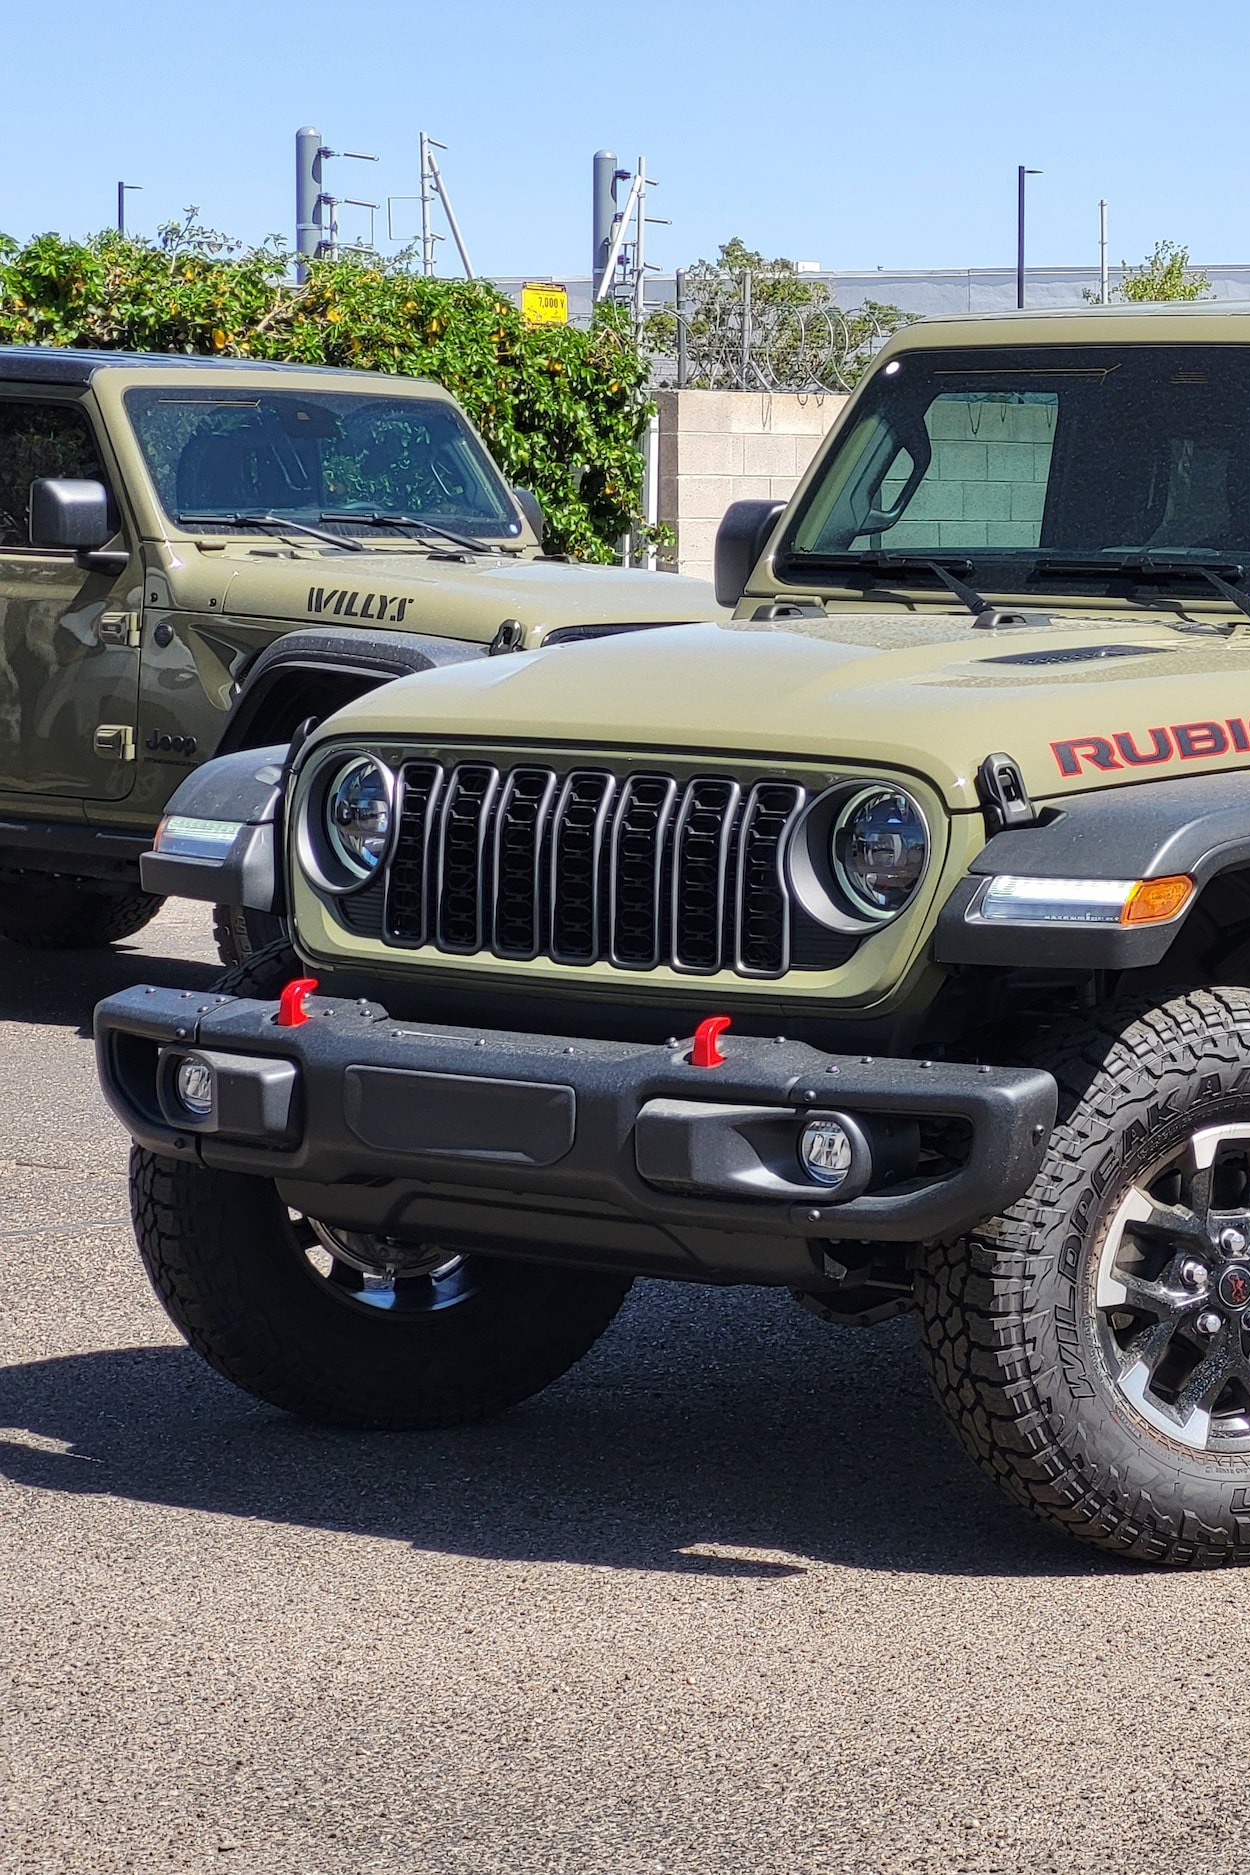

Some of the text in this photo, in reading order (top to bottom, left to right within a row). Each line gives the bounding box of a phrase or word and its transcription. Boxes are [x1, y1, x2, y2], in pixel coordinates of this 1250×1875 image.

[538, 296, 559, 309] 7,000
[307, 587, 415, 622] WILLYS
[1054, 1086, 1184, 1400] WILDPEAK
